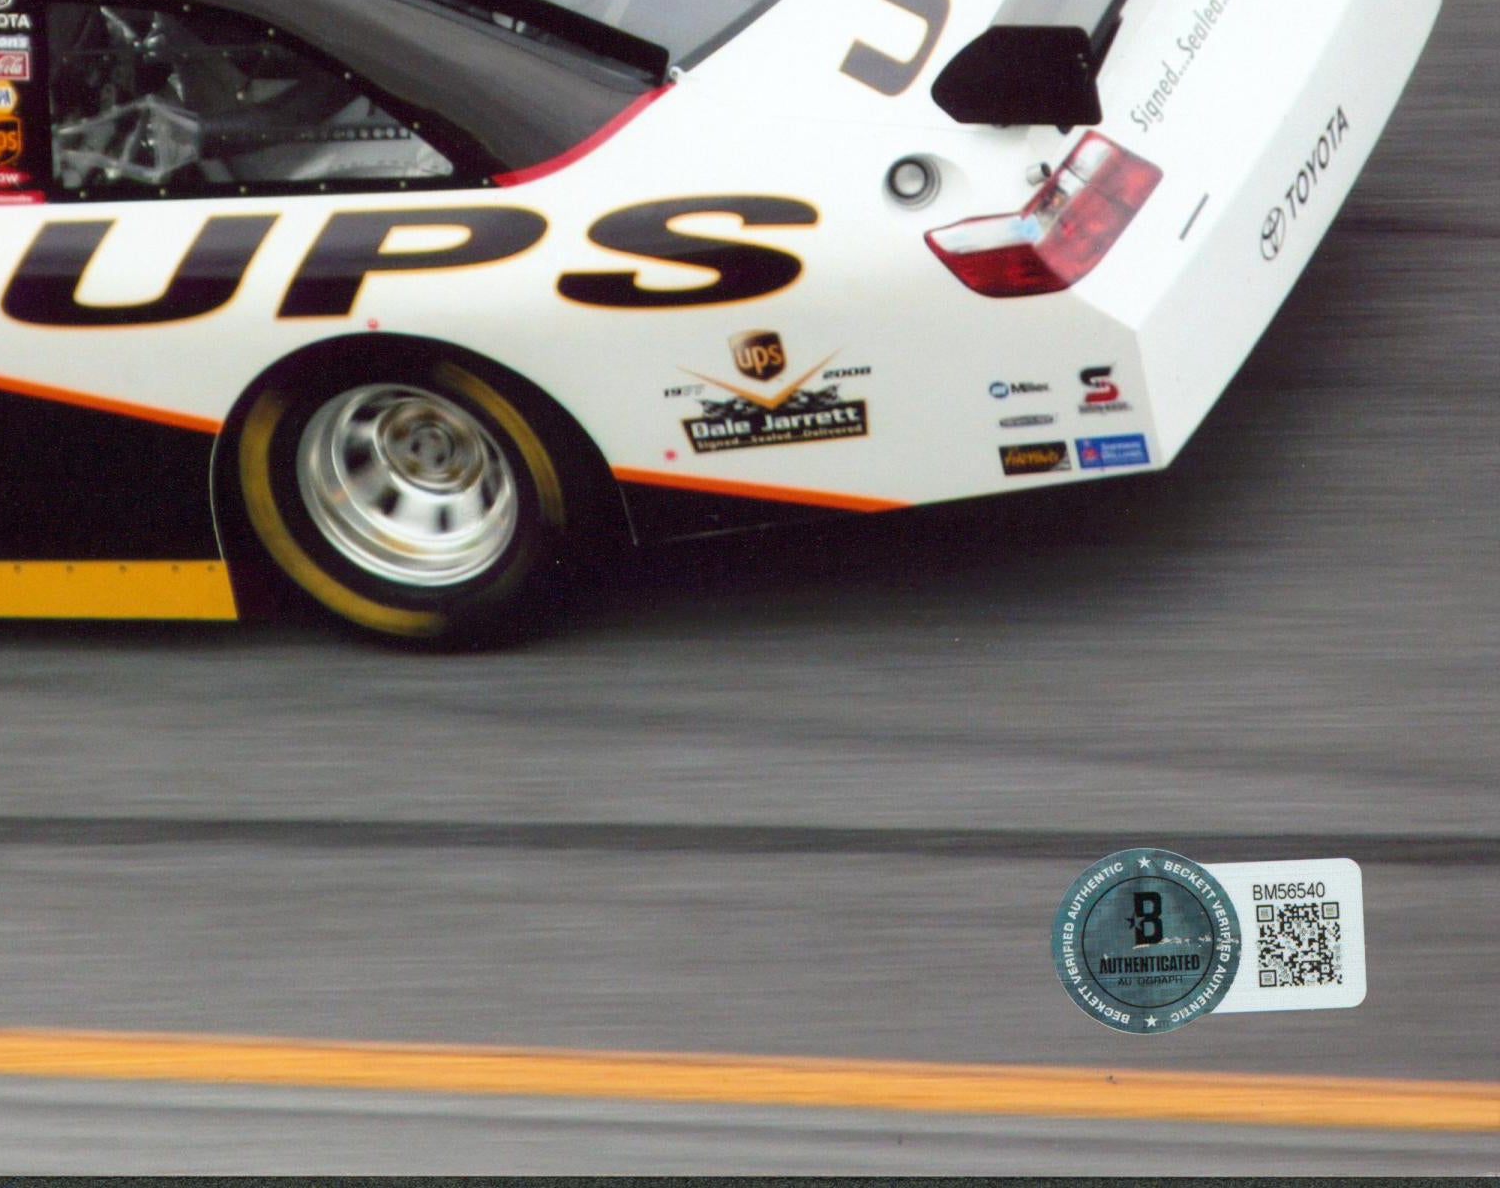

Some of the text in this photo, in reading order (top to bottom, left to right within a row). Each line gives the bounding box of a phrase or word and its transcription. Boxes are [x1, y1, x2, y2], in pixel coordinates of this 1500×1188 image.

[1285, 105, 1350, 220] TOYOTA
[0, 192, 822, 328] UPS
[734, 344, 782, 375] ups
[822, 366, 872, 380] 2008
[690, 407, 860, 439] Dale Jarrett
